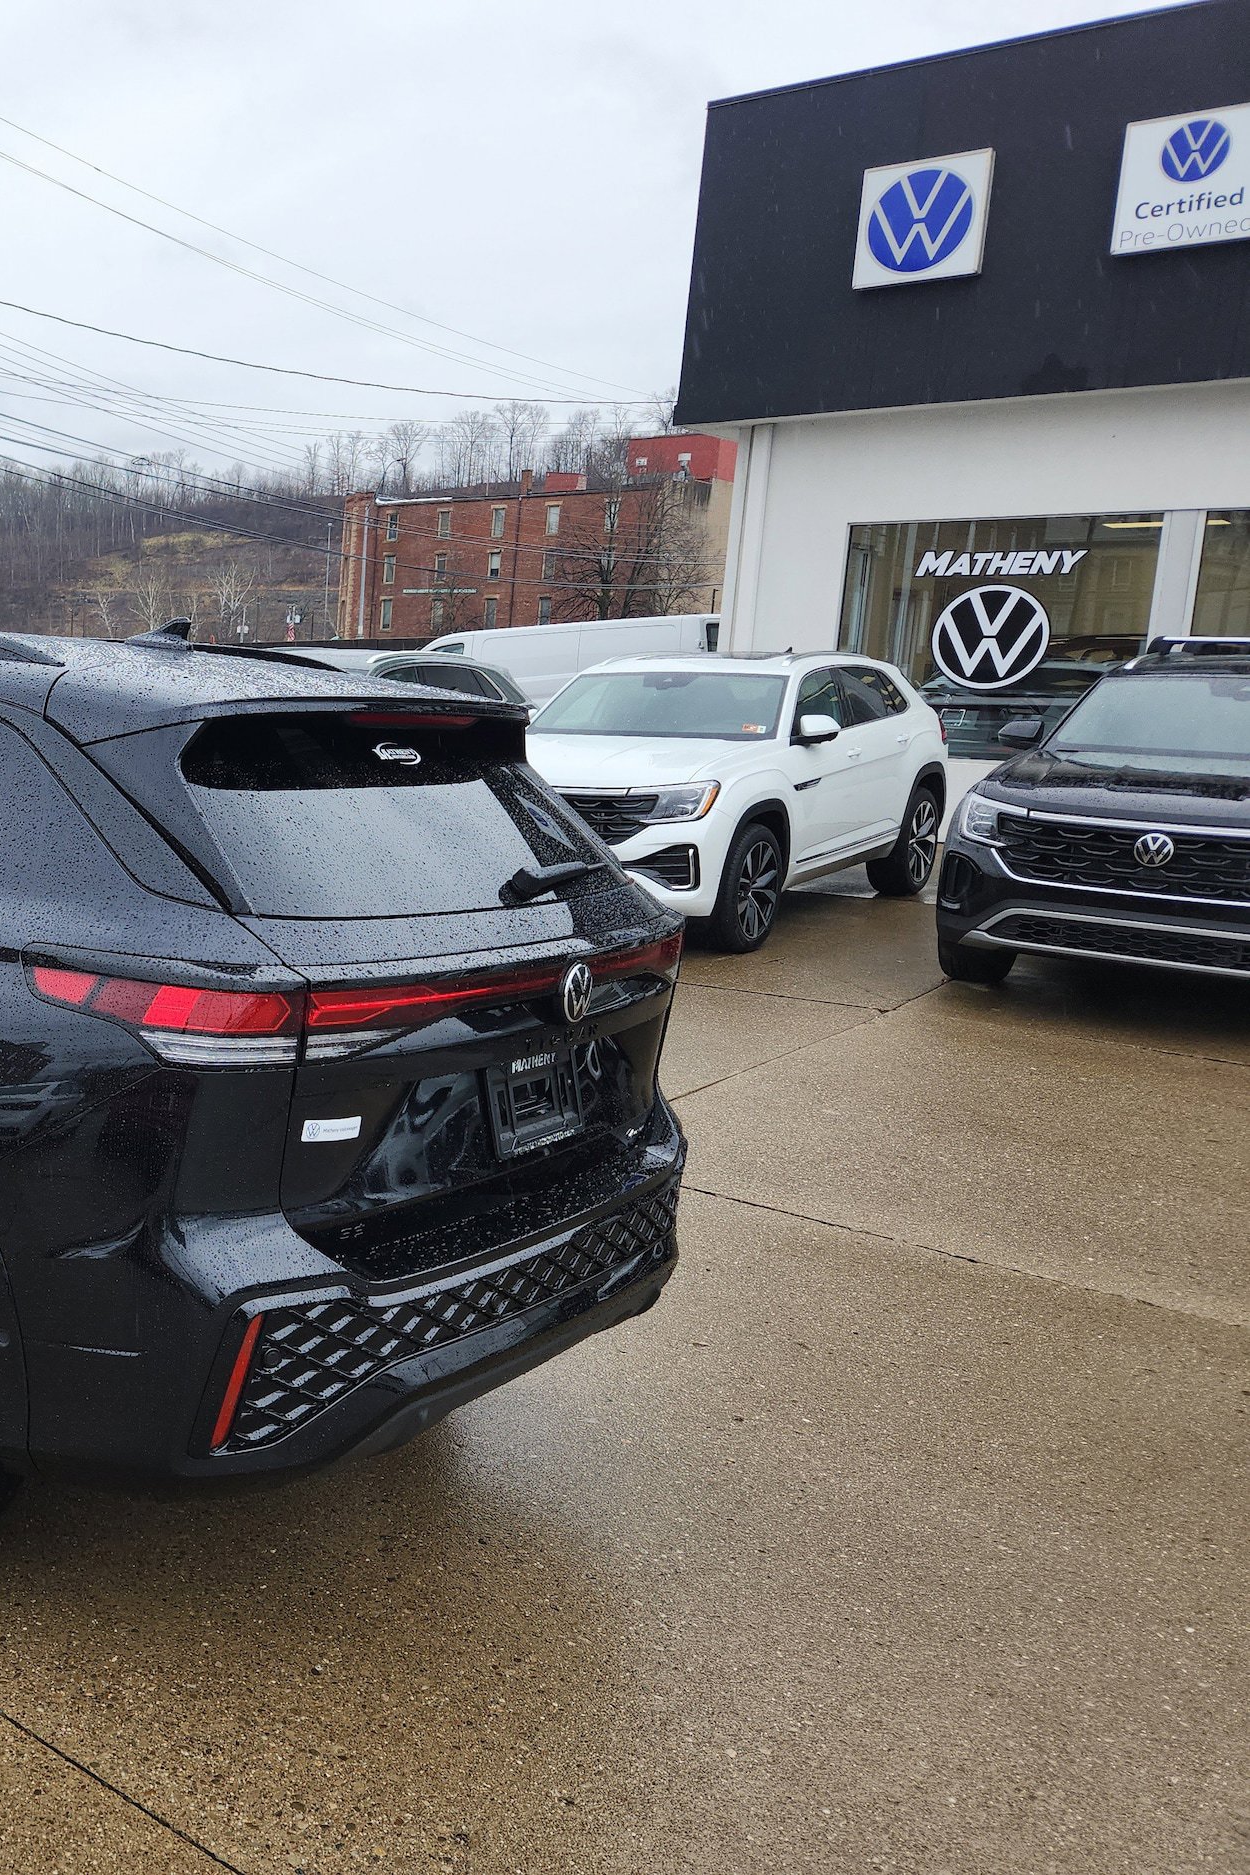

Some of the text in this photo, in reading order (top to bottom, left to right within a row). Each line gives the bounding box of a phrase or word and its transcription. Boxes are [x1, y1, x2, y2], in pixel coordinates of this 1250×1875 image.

[1135, 187, 1245, 220] Certified
[914, 549, 1089, 577] MATHENY
[512, 1052, 556, 1074] MATHENY
